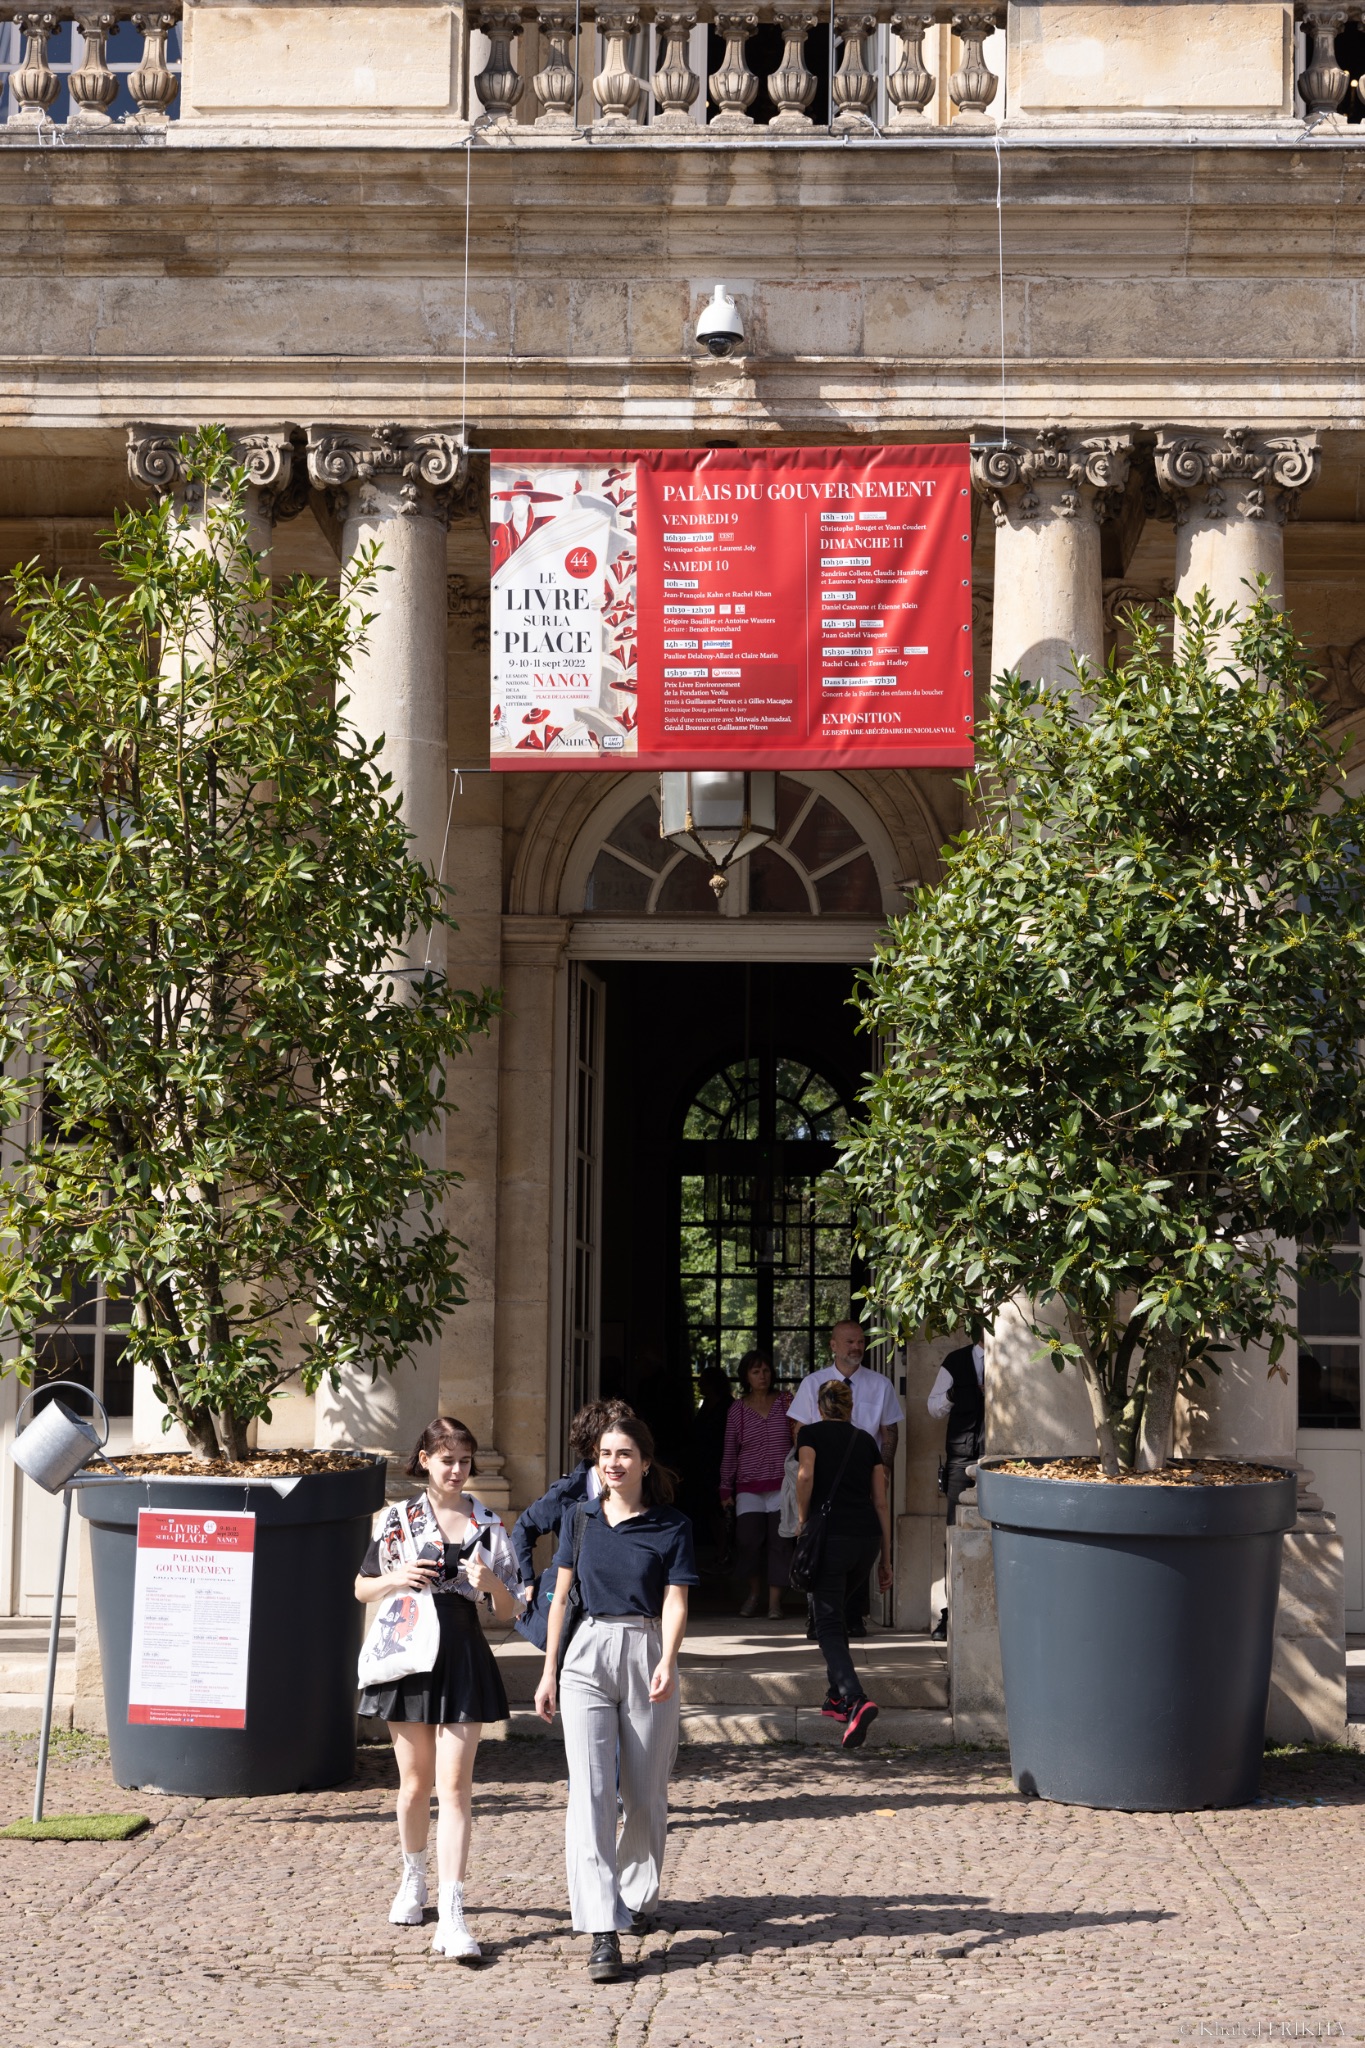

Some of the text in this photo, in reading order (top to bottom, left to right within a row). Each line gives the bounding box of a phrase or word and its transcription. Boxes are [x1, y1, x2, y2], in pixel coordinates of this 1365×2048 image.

[663, 481, 936, 501] PALAIS DU GOUVERNEMENT
[663, 513, 738, 525] VENDREDI 9
[820, 537, 903, 549] DIMANCHE 11
[663, 560, 729, 572] SAMEDI 10
[540, 572, 556, 583] LE
[505, 589, 590, 610] LIVRE
[524, 615, 570, 626] SUR LA
[502, 632, 592, 653] PLACE
[824, 648, 871, 656] 15h30 16h30
[542, 659, 586, 669] sept 2022
[533, 673, 592, 687] NANCY
[822, 712, 901, 725] EXPOSITION
[168, 1524, 200, 1534] LIVRE
[175, 1534, 208, 1543] PLACE
[173, 1554, 204, 1562] PALAIS
[156, 1564, 233, 1574] GOUVERNEMENT
